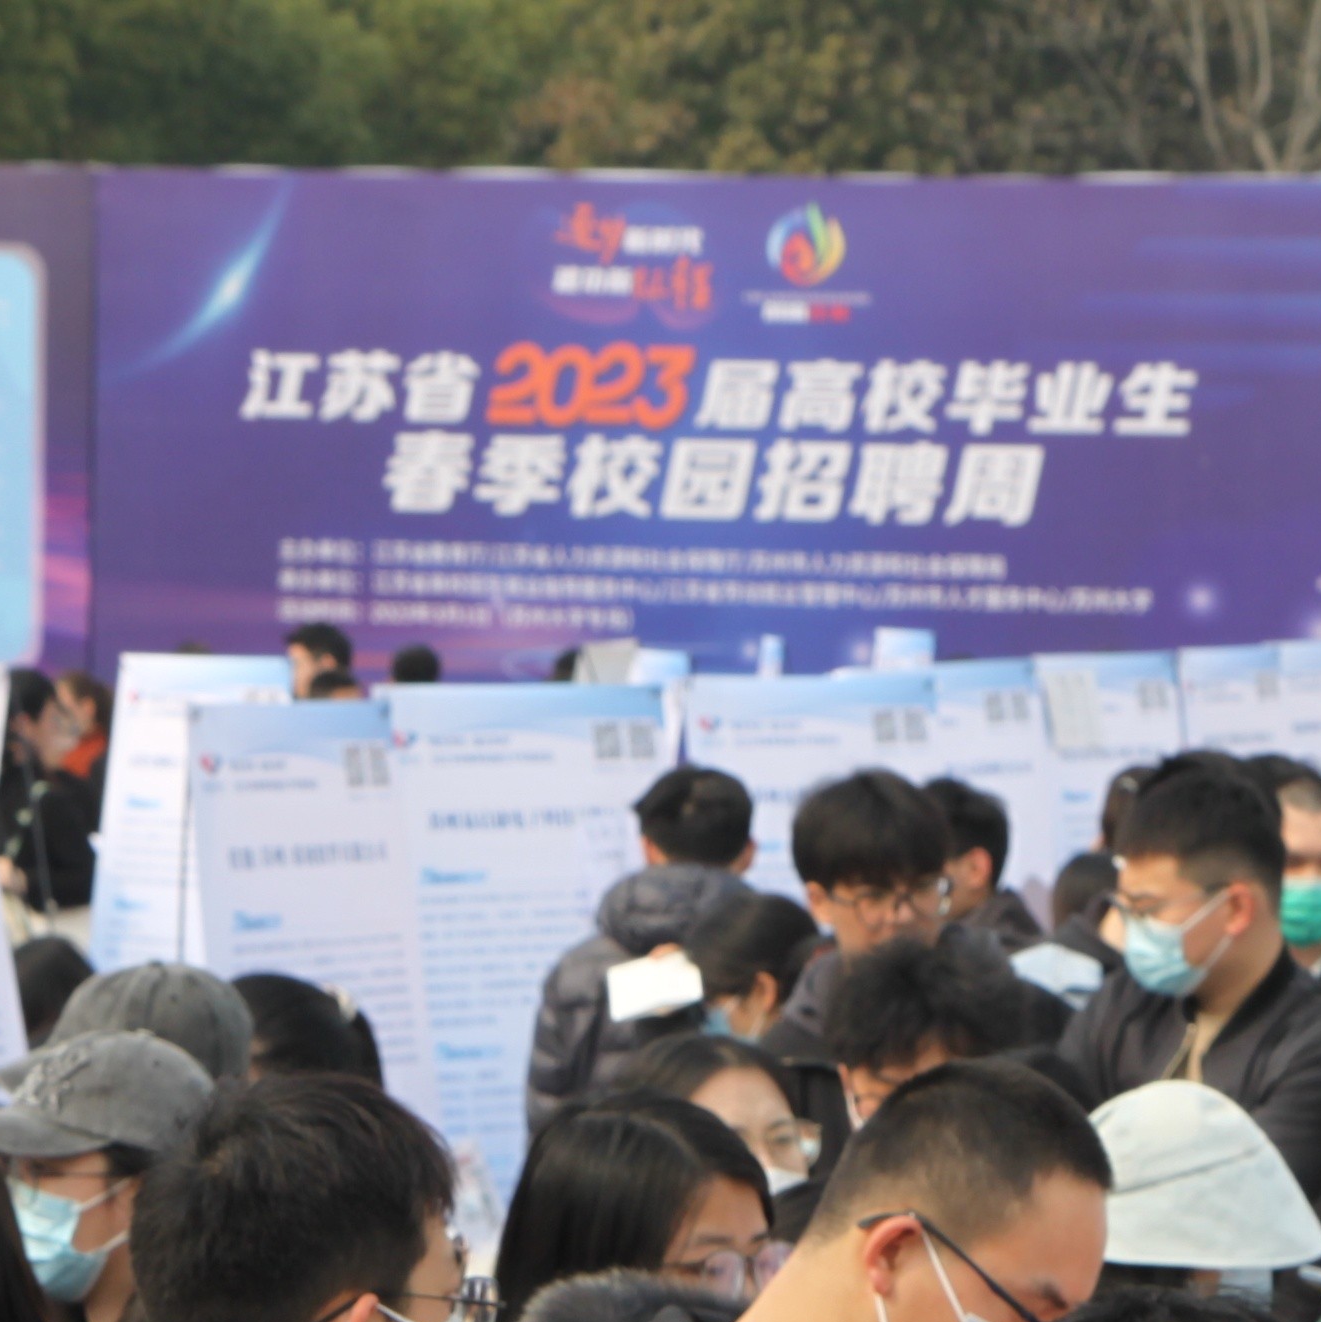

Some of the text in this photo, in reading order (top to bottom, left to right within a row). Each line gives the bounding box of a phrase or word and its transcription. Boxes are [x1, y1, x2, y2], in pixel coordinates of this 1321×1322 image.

[241, 341, 1198, 436] 江苏省2023届高校毕业生
[382, 429, 1045, 527] 春季校园招聘周
